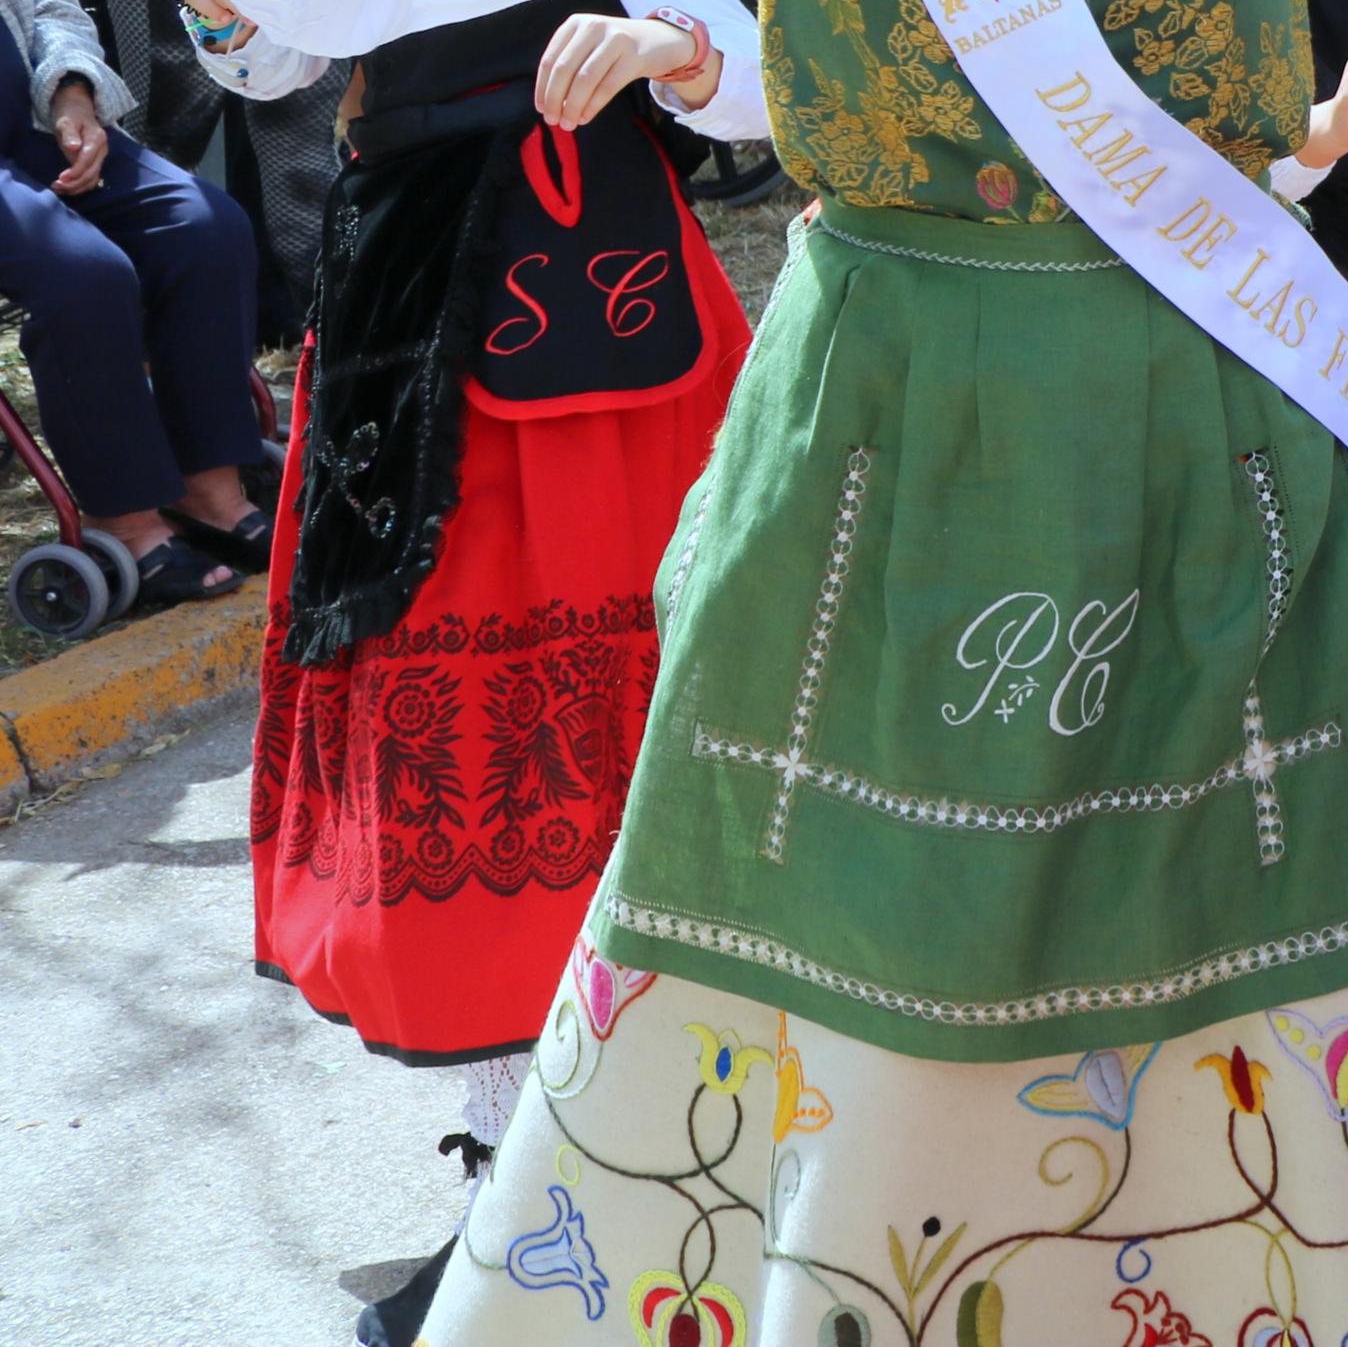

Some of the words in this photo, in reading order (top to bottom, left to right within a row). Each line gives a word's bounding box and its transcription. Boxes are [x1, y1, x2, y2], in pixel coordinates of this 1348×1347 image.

[485, 253, 549, 355] S
[1034, 70, 1168, 208] DAMA
[1154, 197, 1238, 270] DE
[1225, 247, 1319, 349] LAS
